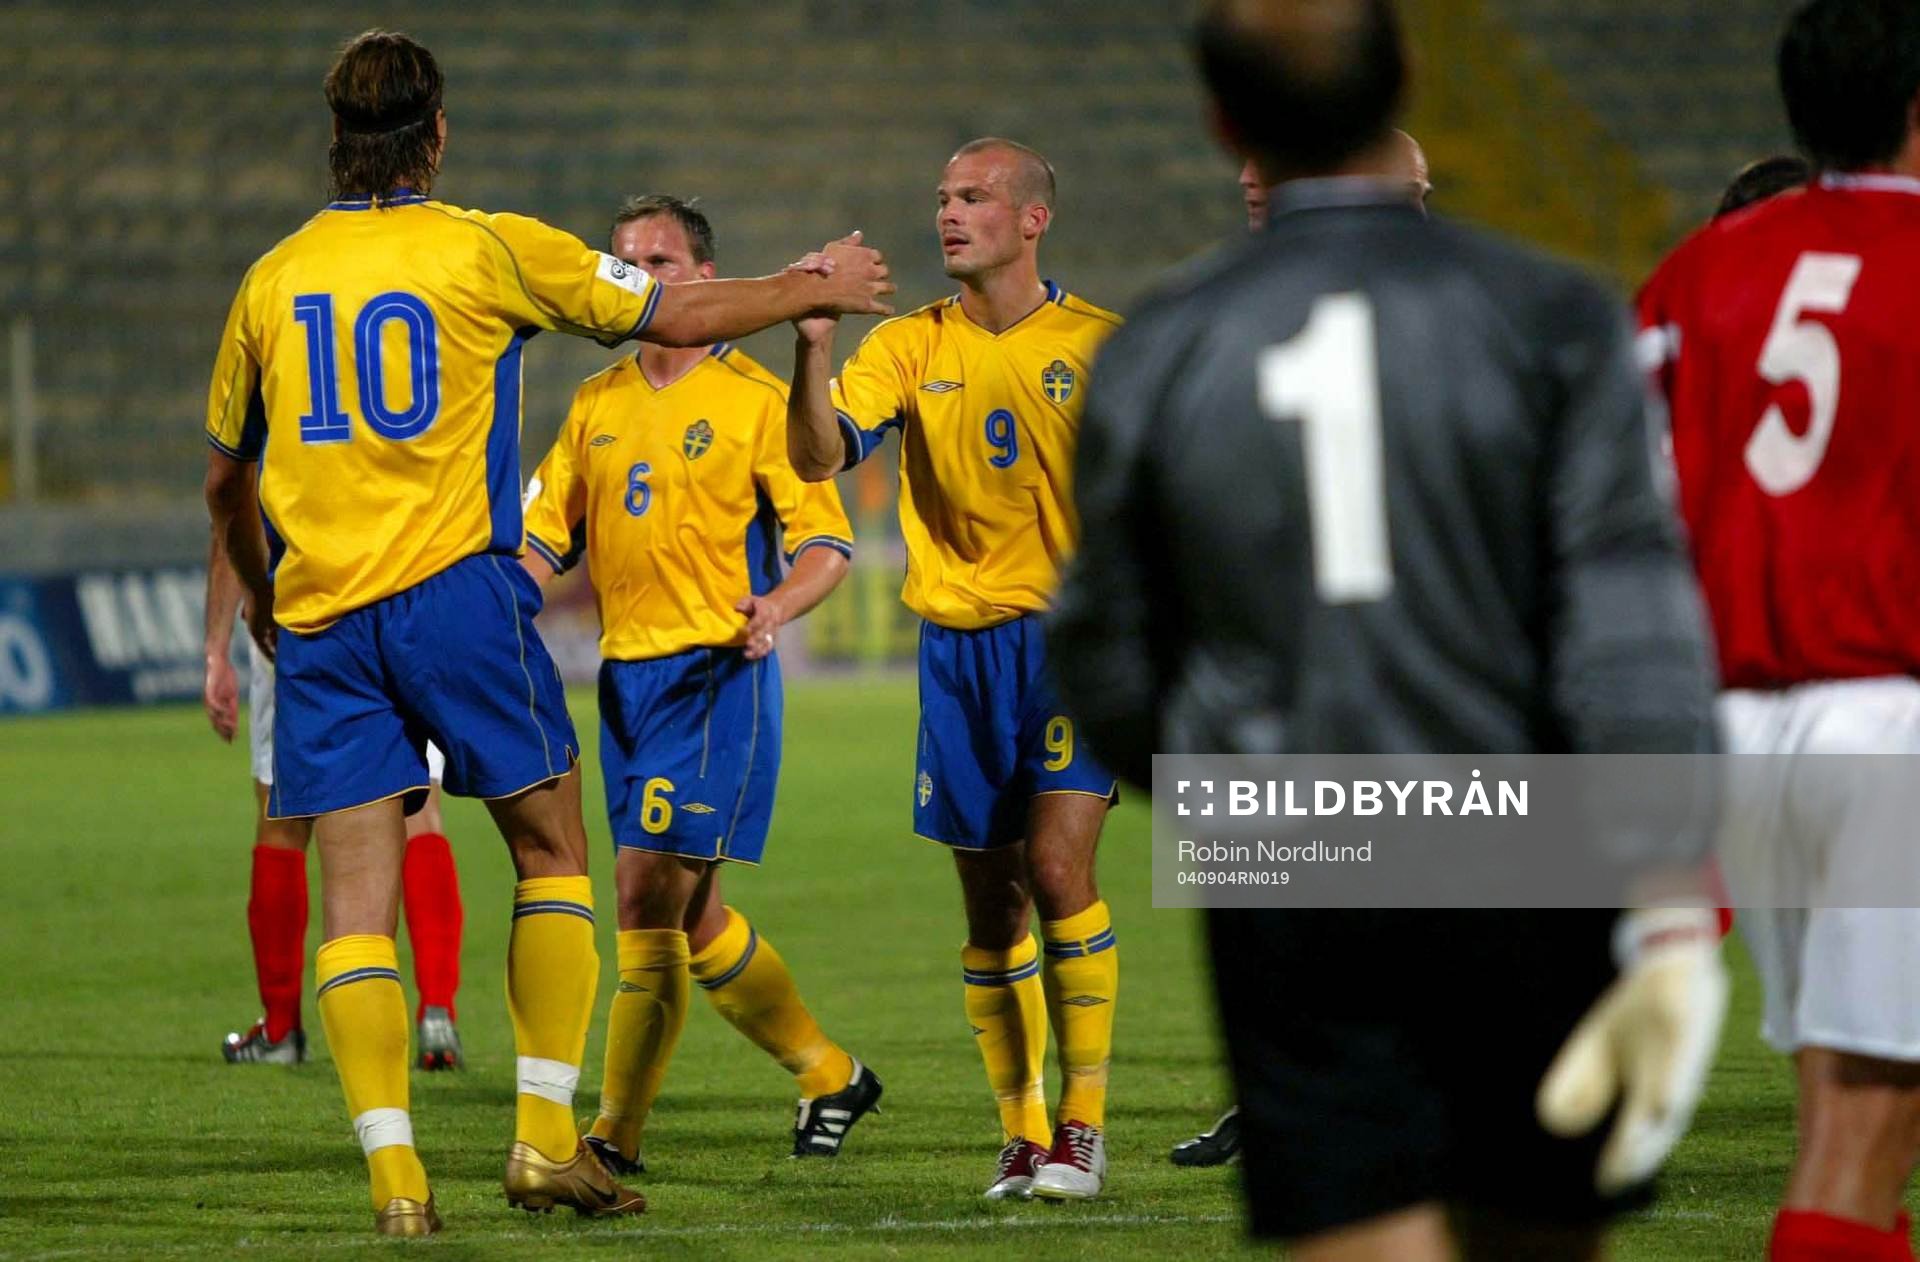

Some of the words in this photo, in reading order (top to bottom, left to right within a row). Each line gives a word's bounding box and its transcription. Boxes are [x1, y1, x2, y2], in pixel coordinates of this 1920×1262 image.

[293, 290, 440, 444] 10
[1744, 251, 1862, 497] 5
[985, 408, 1019, 468] 9
[1258, 291, 1394, 604] 1
[624, 462, 651, 517] 6
[1043, 715, 1075, 772] 9
[640, 777, 675, 834] 6
